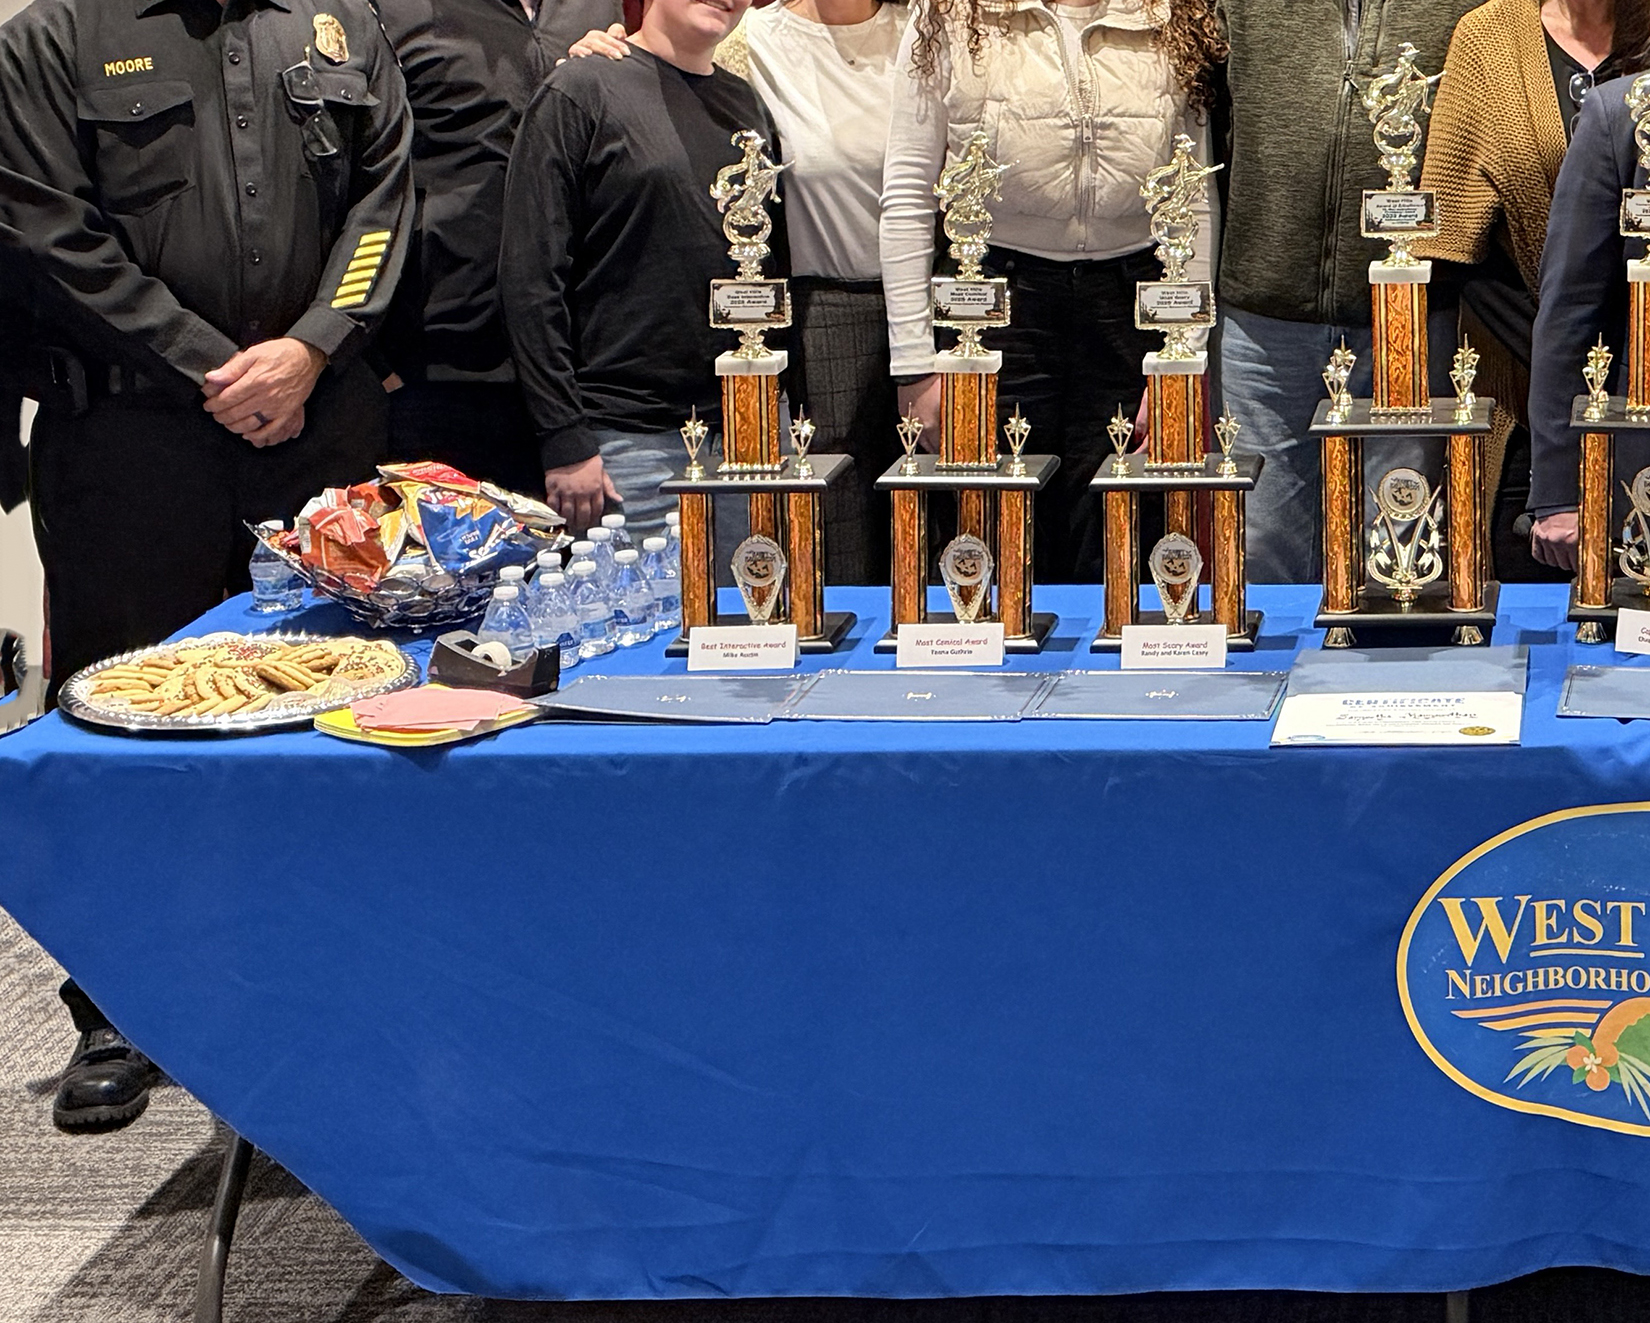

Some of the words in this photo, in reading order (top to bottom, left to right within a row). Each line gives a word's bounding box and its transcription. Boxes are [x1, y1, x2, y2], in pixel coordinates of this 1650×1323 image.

[104, 57, 154, 77] MOORE
[701, 642, 717, 650] Best
[1162, 642, 1184, 650] Scary
